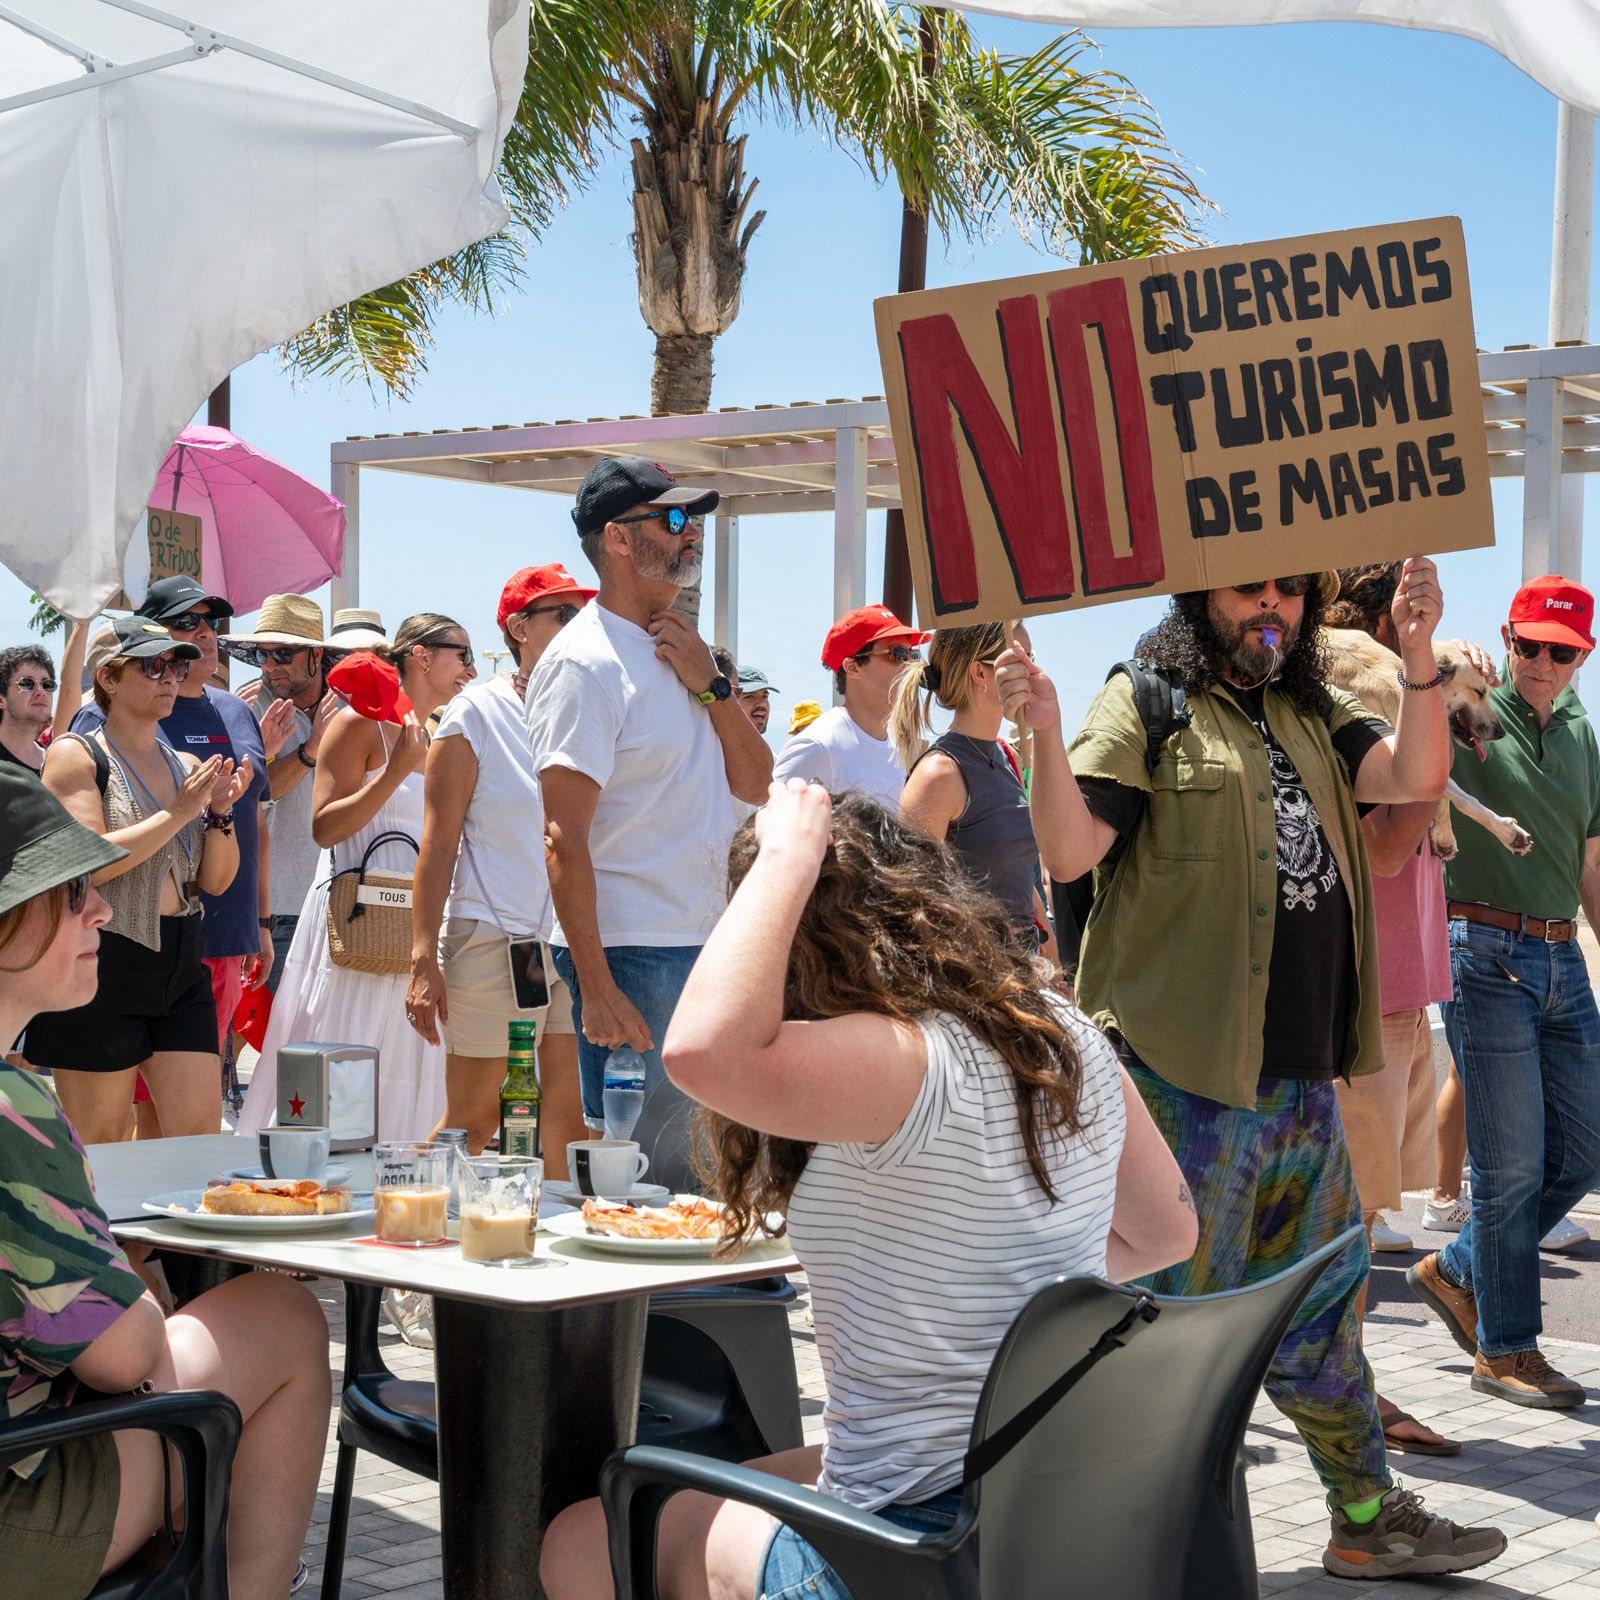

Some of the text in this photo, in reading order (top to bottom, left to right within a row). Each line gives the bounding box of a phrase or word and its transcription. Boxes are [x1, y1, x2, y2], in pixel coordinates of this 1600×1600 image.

[1140, 237, 1452, 354] QUEREMOS
[897, 277, 1165, 615] NO
[1185, 432, 1466, 539] DE MASAS
[165, 514, 181, 542] de
[378, 891, 406, 903] TOUS
